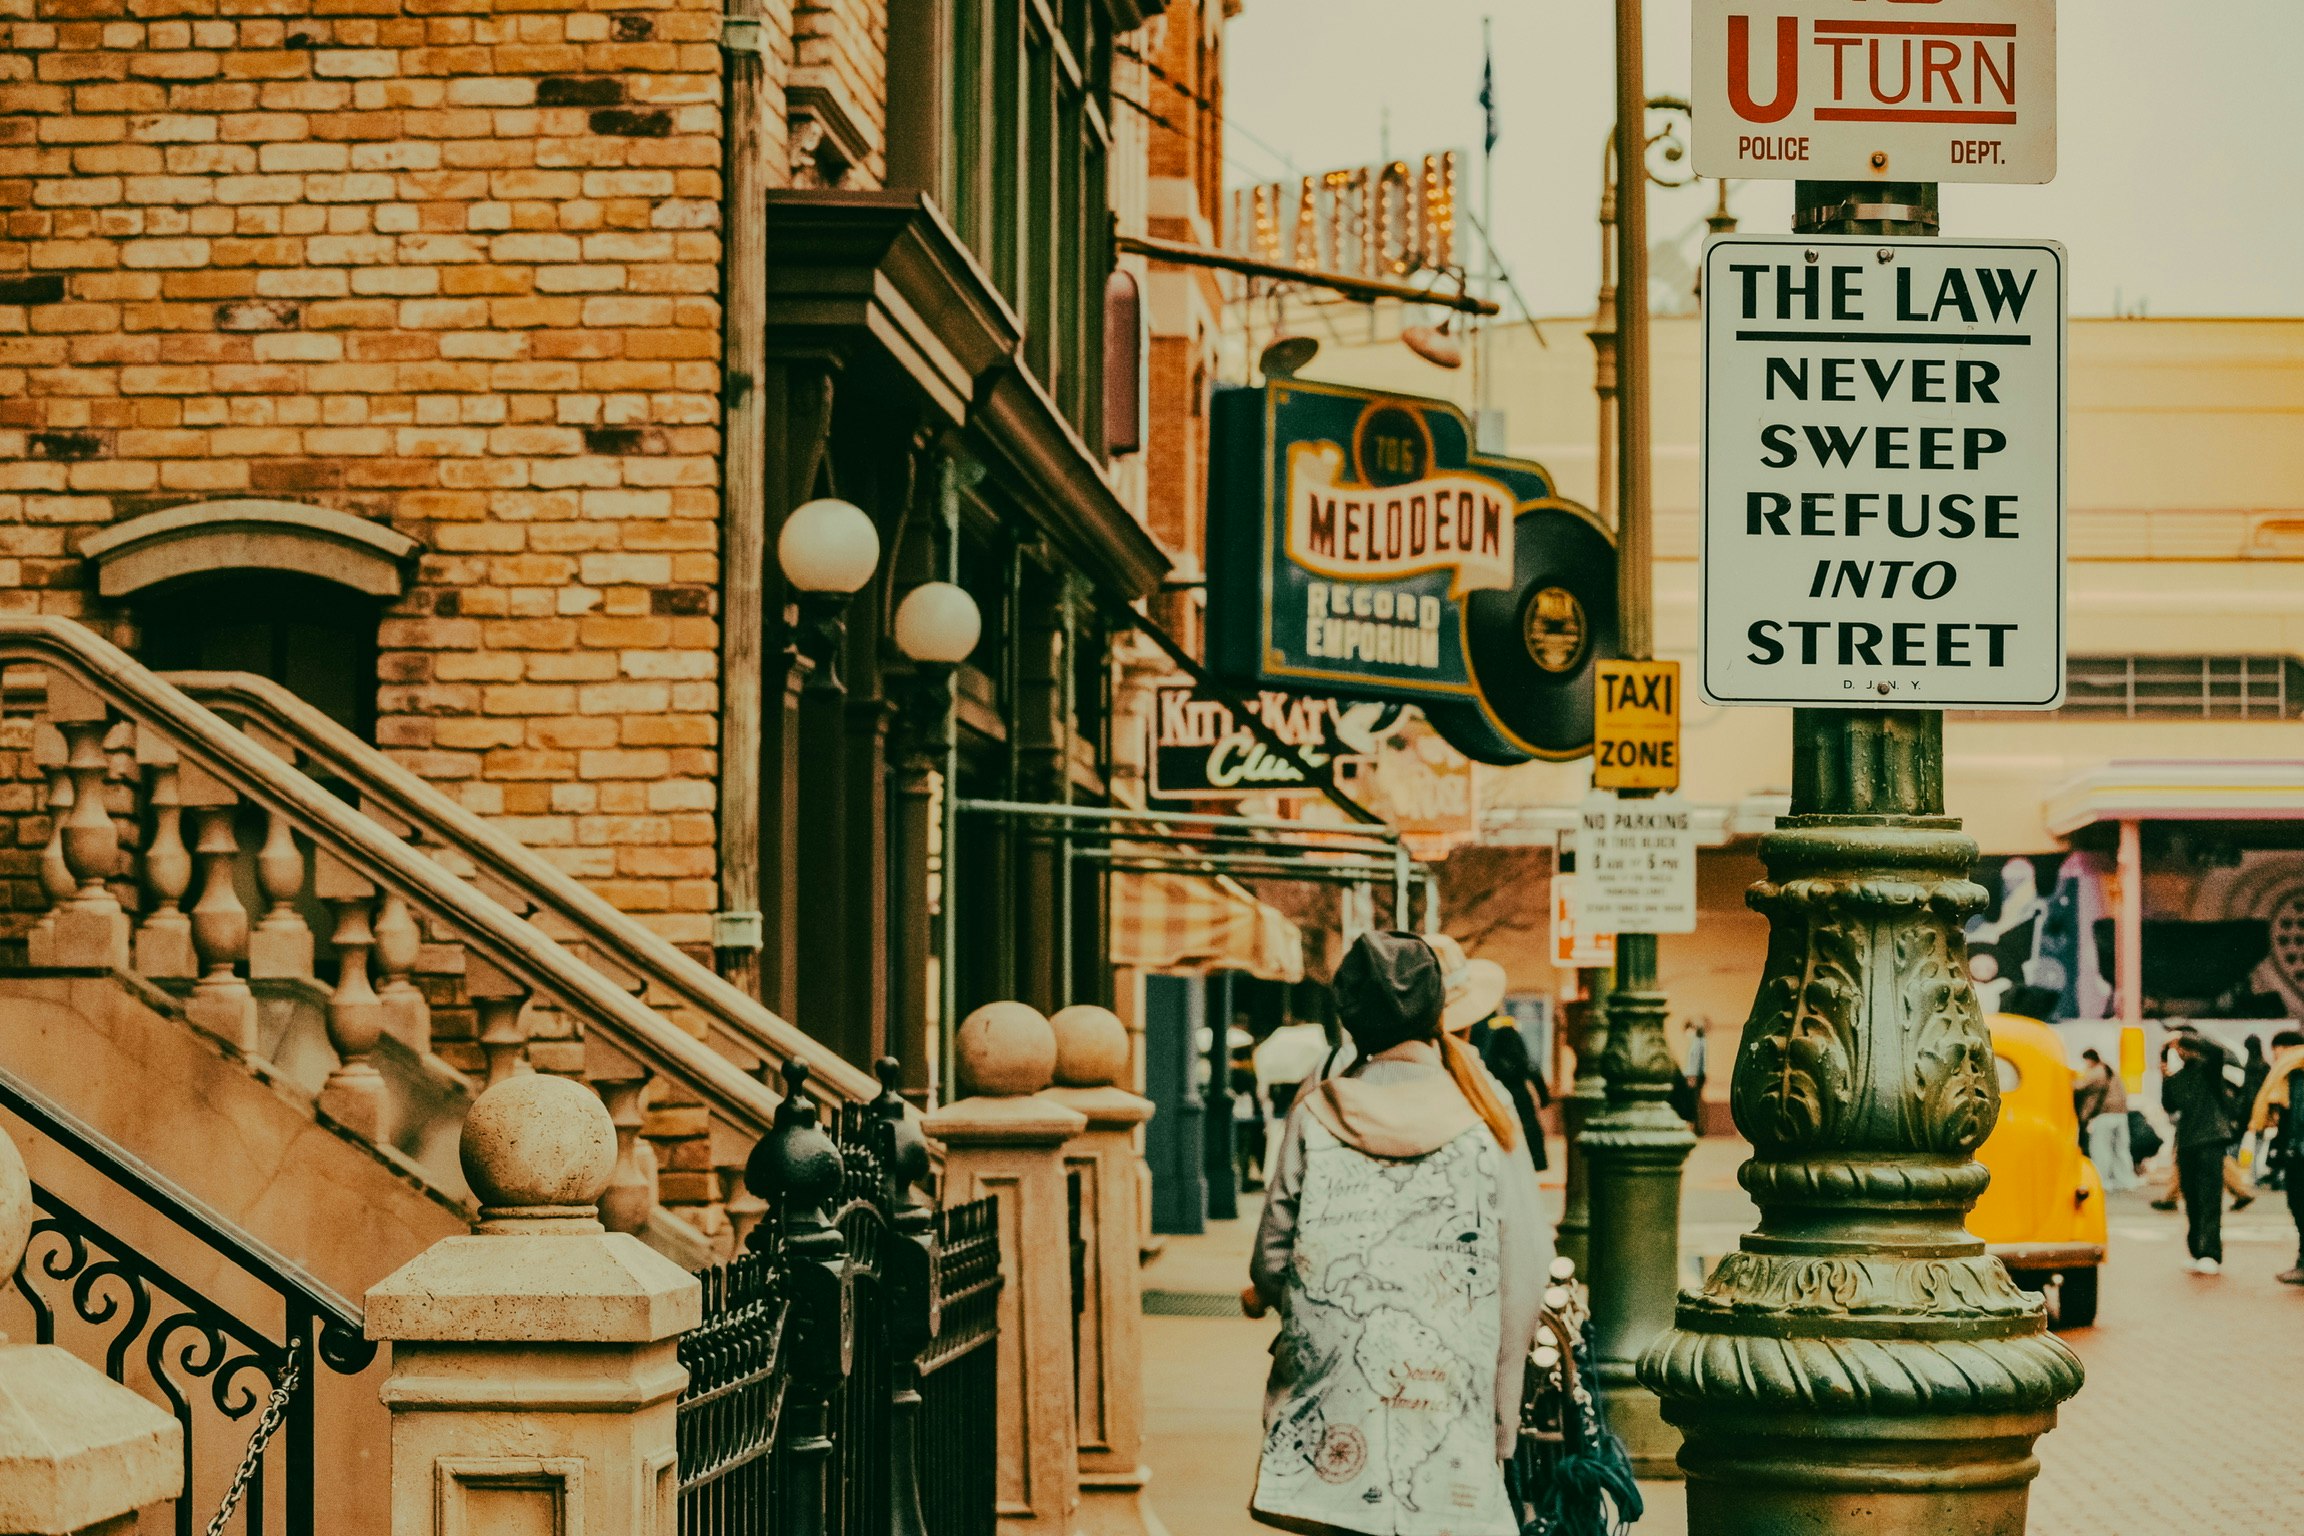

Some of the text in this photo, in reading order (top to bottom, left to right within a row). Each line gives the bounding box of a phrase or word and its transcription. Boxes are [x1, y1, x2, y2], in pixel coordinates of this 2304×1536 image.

[1727, 15, 2016, 124] U TURN
[1738, 136, 2006, 165] POLICE DEPT.
[1729, 263, 2038, 325] THE LAW
[1765, 357, 2001, 404] NEVER
[1759, 423, 2008, 470] SWEEP
[1307, 490, 1502, 562] MELODEON
[1745, 491, 2020, 540] REFUSE
[1808, 559, 1958, 600] INTO
[1307, 582, 1440, 629] RECORD
[1306, 617, 1440, 668] EMPORIUM
[1746, 619, 2019, 668] STREET
[1601, 674, 1672, 717] TAXI
[1600, 740, 1675, 768] ZONE
[1583, 812, 1689, 830] NO PARKING
